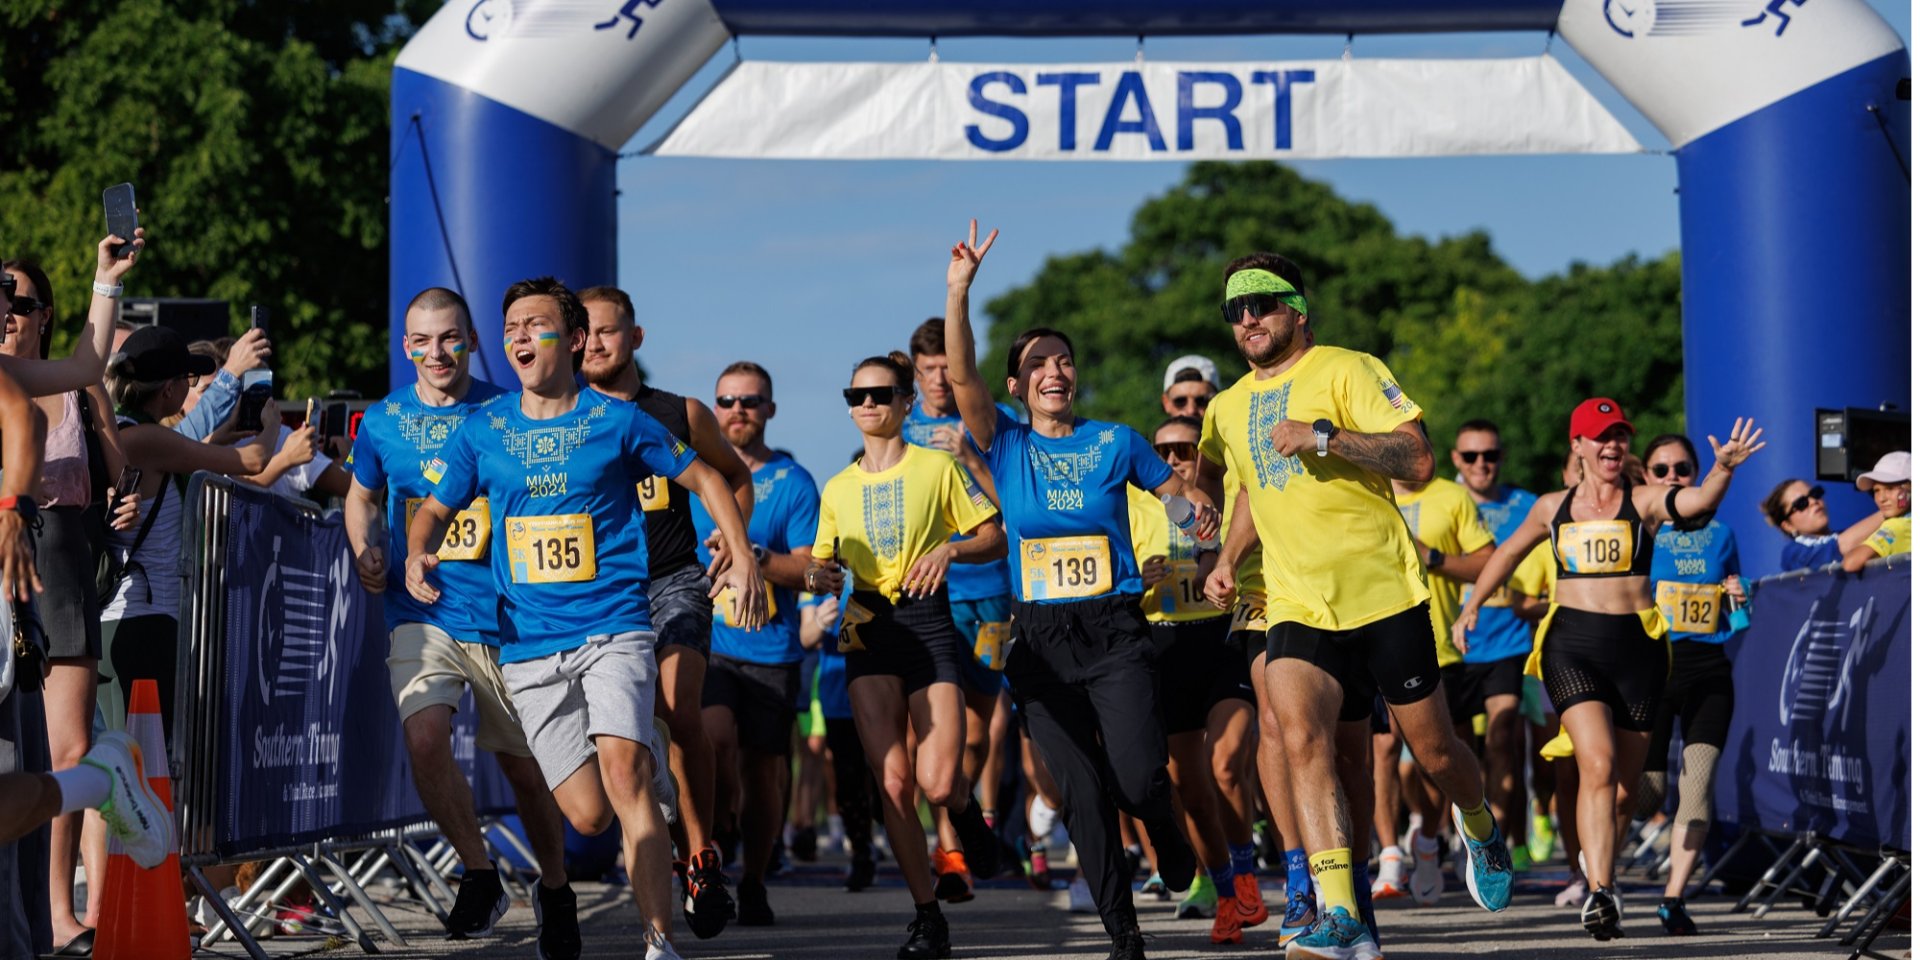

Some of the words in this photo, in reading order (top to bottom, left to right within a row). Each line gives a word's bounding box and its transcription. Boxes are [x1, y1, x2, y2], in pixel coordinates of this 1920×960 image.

[964, 71, 1316, 152] START
[526, 472, 568, 486] MIAMI
[529, 482, 567, 498] 2024
[1047, 489, 1084, 500] MIAMI
[1047, 498, 1084, 510] 2024
[446, 518, 477, 548] 33
[532, 537, 581, 570] 135
[1584, 538, 1621, 564] 108
[1052, 556, 1098, 587] 139
[1677, 565, 1707, 576] 2024
[1680, 601, 1712, 624] 132
[253, 722, 304, 769] Southern
[1767, 738, 1818, 777] Southern
[1820, 744, 1862, 794] Timing
